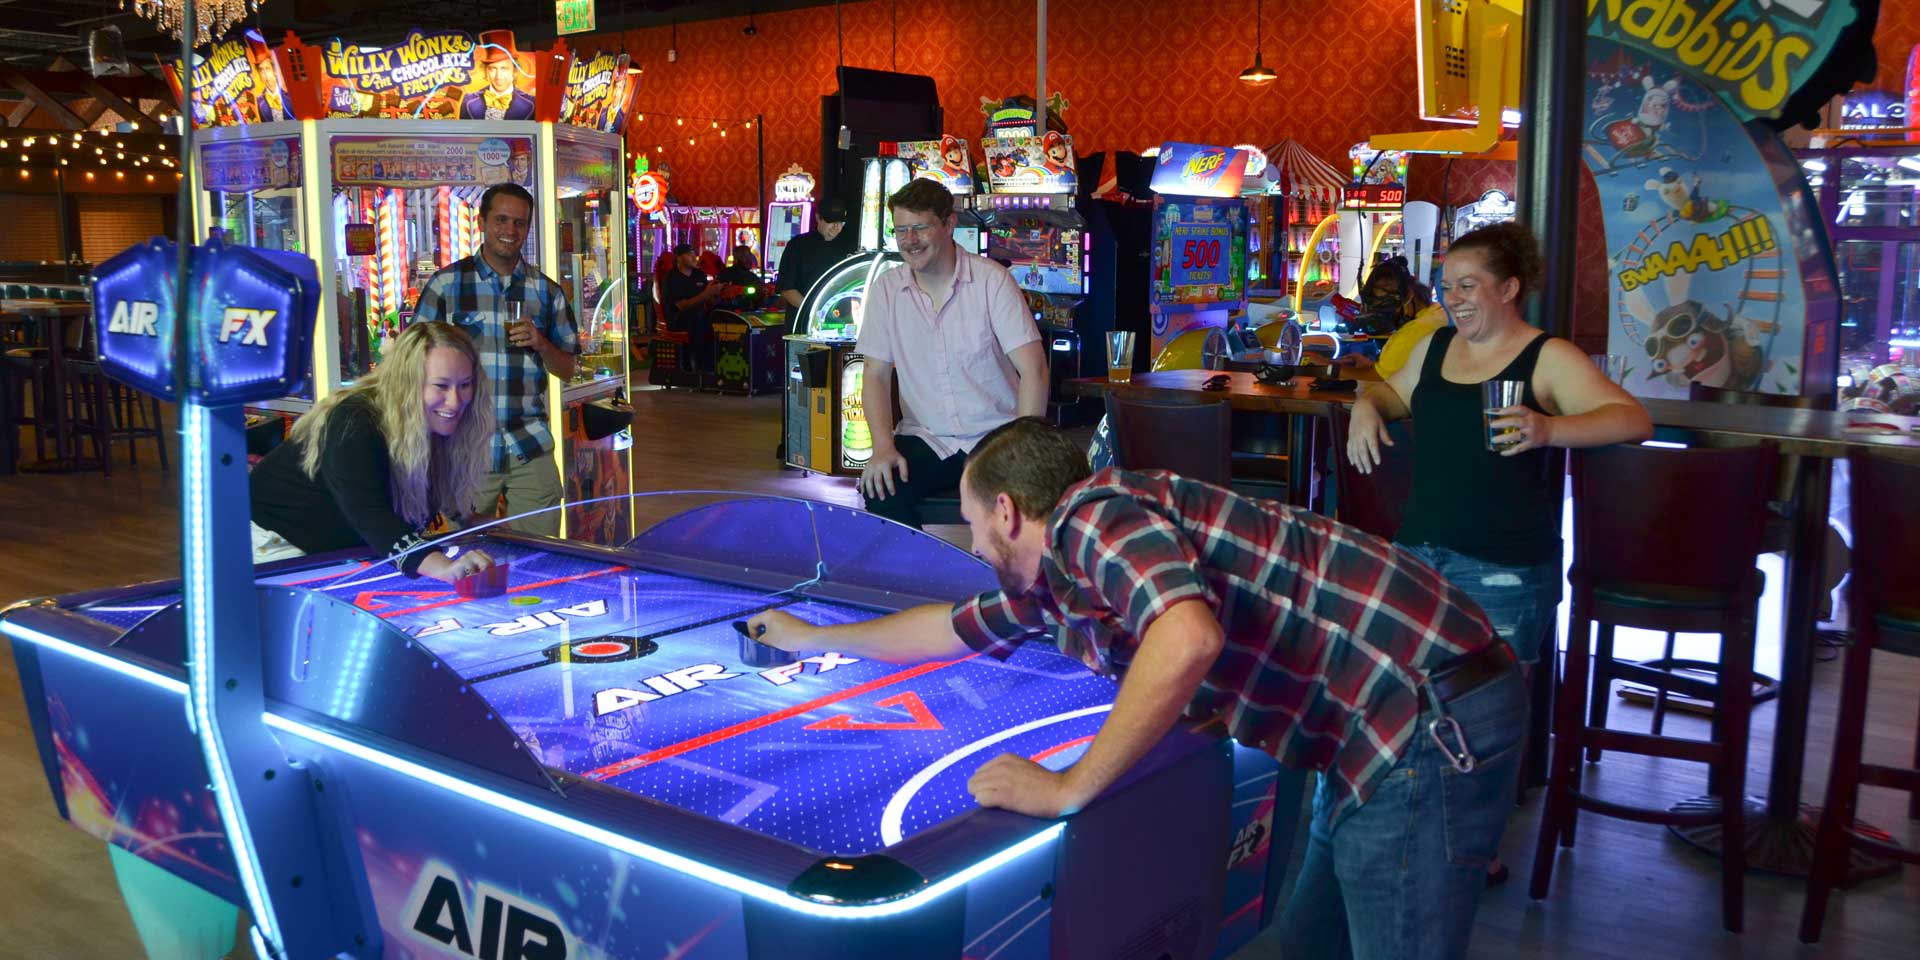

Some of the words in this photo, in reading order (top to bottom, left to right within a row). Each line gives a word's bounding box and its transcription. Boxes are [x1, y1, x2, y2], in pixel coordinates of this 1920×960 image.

[564, 0, 588, 31] EXIT
[209, 41, 245, 74] WONKA
[328, 45, 393, 76] WILLY
[397, 33, 471, 65] WONKA
[391, 52, 471, 82] CHOCOLATE
[213, 57, 251, 92] CHOCOLATE
[401, 67, 466, 96] FACTORY
[446, 146, 464, 155] 2000
[483, 152, 500, 161] 1000
[1184, 152, 1226, 177] NERF
[1380, 190, 1402, 201] 500
[1176, 226, 1188, 235] NERF
[1211, 226, 1228, 235] BONUS
[1183, 240, 1220, 269] 500
[1619, 214, 1775, 292] BWAAAH!!!
[108, 300, 158, 336] AIR
[219, 308, 277, 346] FX
[472, 599, 608, 637] AIR
[593, 663, 747, 717] AIR
[757, 651, 862, 686] FX
[413, 875, 567, 960] AIR
